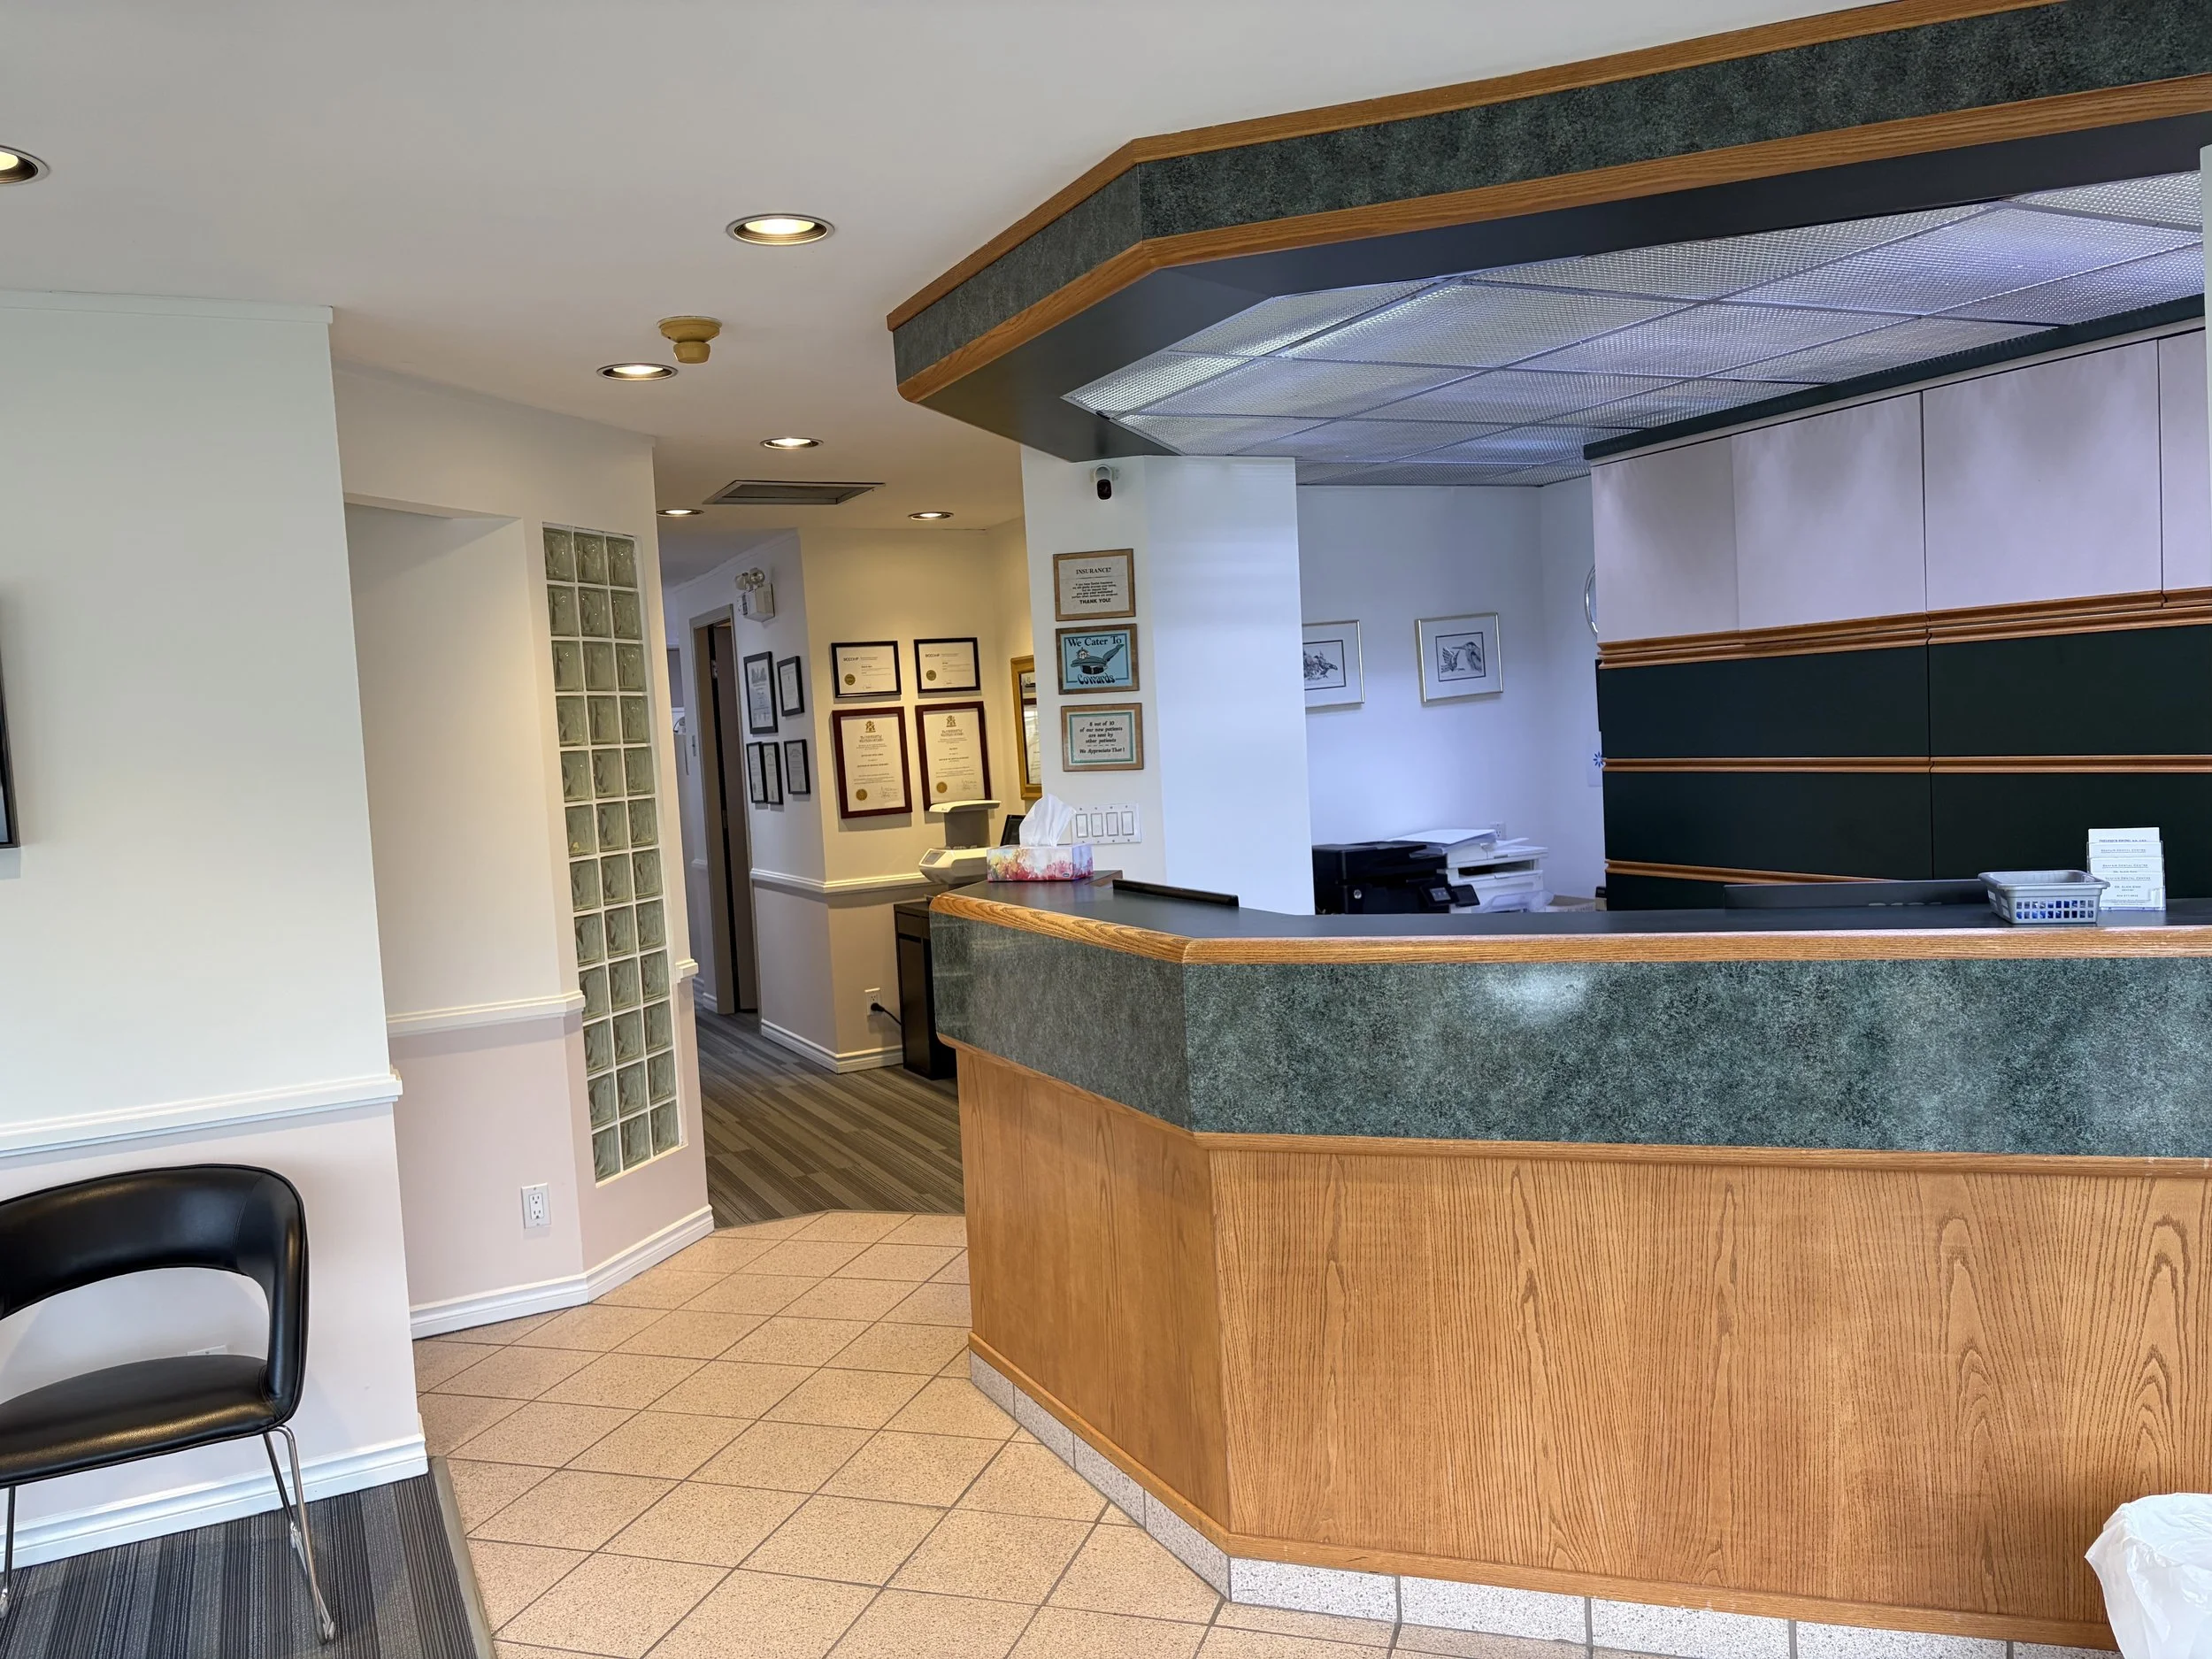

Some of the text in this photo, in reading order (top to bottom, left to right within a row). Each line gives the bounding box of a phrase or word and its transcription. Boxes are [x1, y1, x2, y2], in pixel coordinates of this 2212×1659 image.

[1067, 638, 1082, 647] We
[1084, 637, 1109, 646] Cater
[1077, 672, 1116, 685] Cowards
